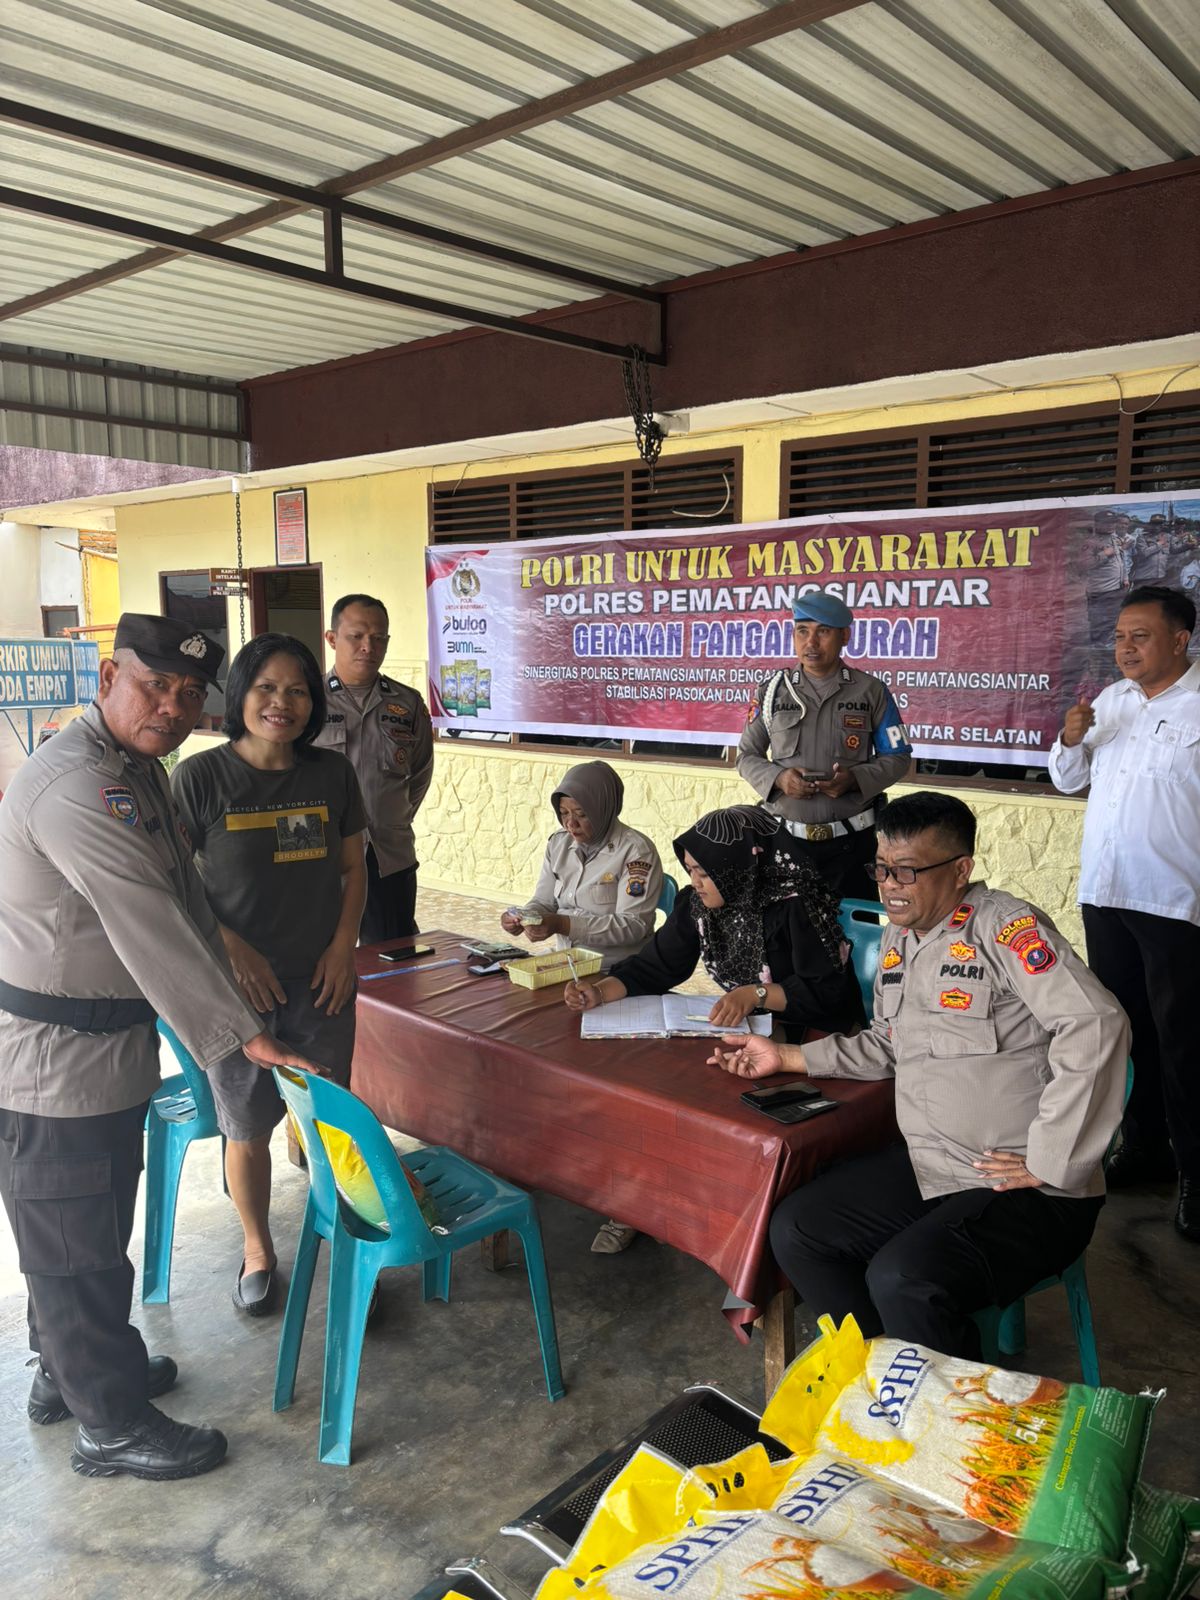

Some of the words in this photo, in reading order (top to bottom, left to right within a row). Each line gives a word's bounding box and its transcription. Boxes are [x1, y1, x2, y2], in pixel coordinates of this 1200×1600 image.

[520, 552, 615, 588] POLRI
[625, 545, 734, 583] UNTUK
[747, 526, 1039, 578] MASYARAKAT
[545, 590, 644, 615] POLRES
[452, 615, 487, 635] bulog
[573, 622, 684, 658] GERAKAN
[840, 617, 940, 659] URAH
[30, 645, 71, 671] UMUM
[26, 674, 67, 701] EMPAT
[524, 666, 578, 679] SINERGITAS
[581, 667, 619, 680] POLRES
[622, 667, 726, 682] PEMATANGSIANTAR
[729, 668, 776, 683] DENGA
[896, 671, 1050, 690] PEMATANGSIANTAR
[606, 685, 667, 700] STABILISASI
[669, 687, 722, 702] PASOKAN
[725, 688, 751, 703] DAN
[838, 702, 870, 712] POLRI
[960, 727, 1042, 745] SELATAN
[940, 964, 985, 981] POLRI
[868, 1347, 929, 1427] SPHP
[1015, 1428, 1039, 1444] 5
[1030, 1415, 1047, 1433] kg
